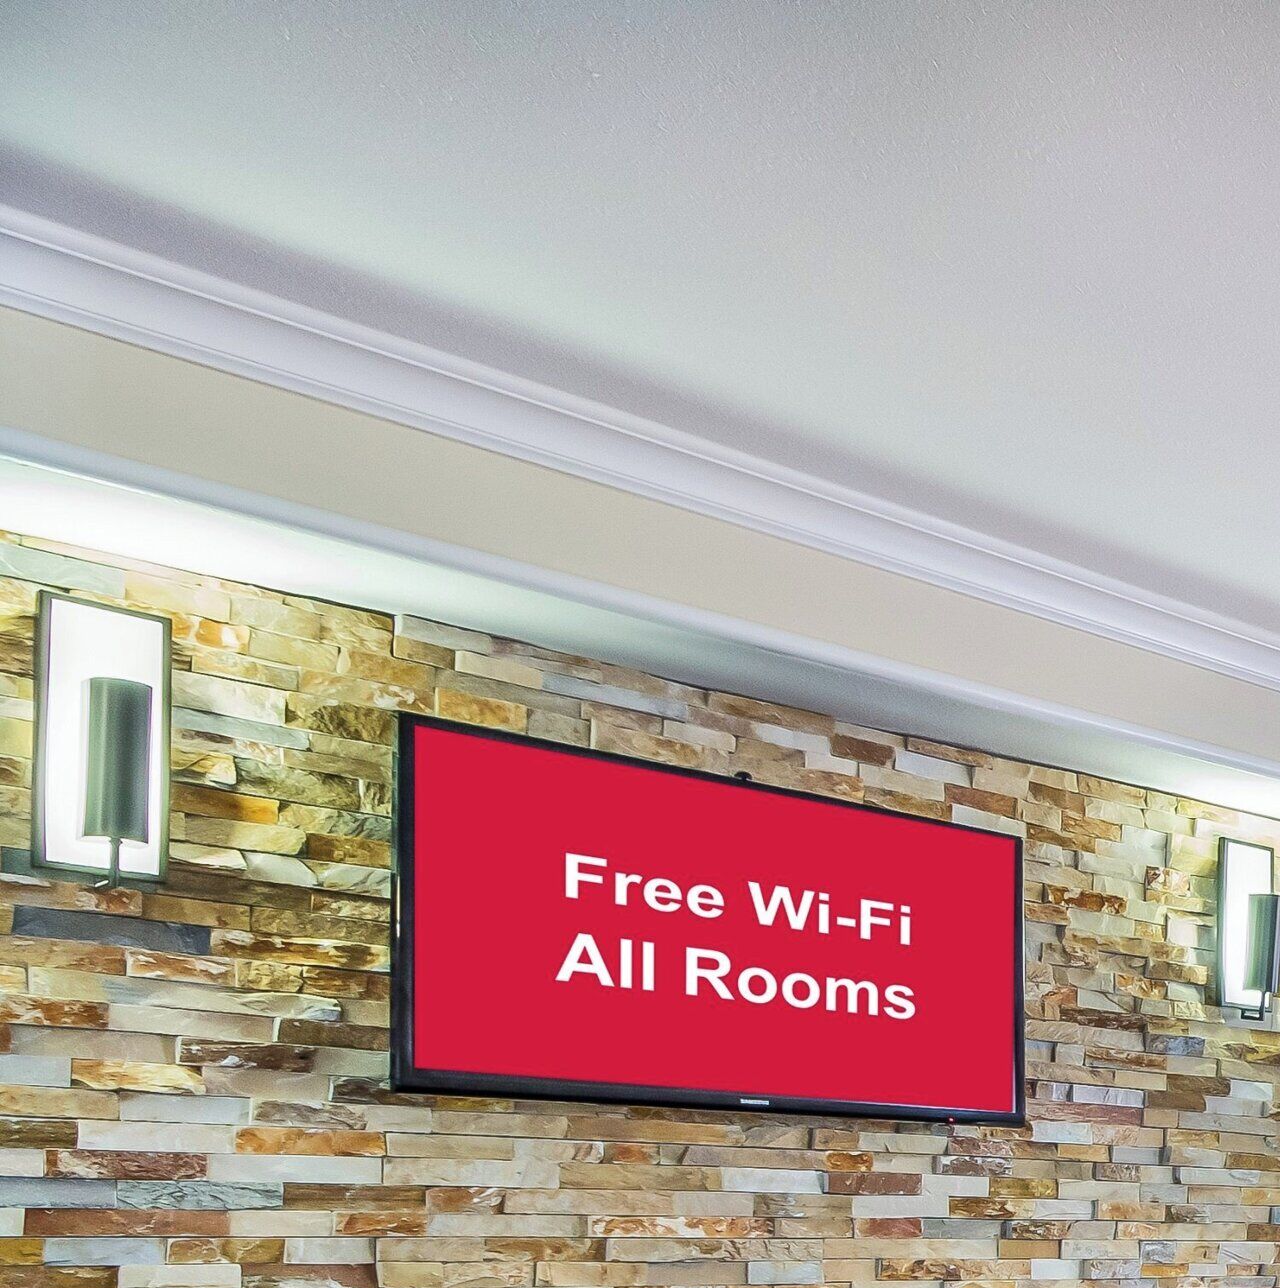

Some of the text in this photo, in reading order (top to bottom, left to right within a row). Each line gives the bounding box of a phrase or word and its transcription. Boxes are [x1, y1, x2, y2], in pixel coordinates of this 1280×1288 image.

[565, 852, 912, 946] Free Wi-Fi
[556, 932, 916, 1020] All Rooms
